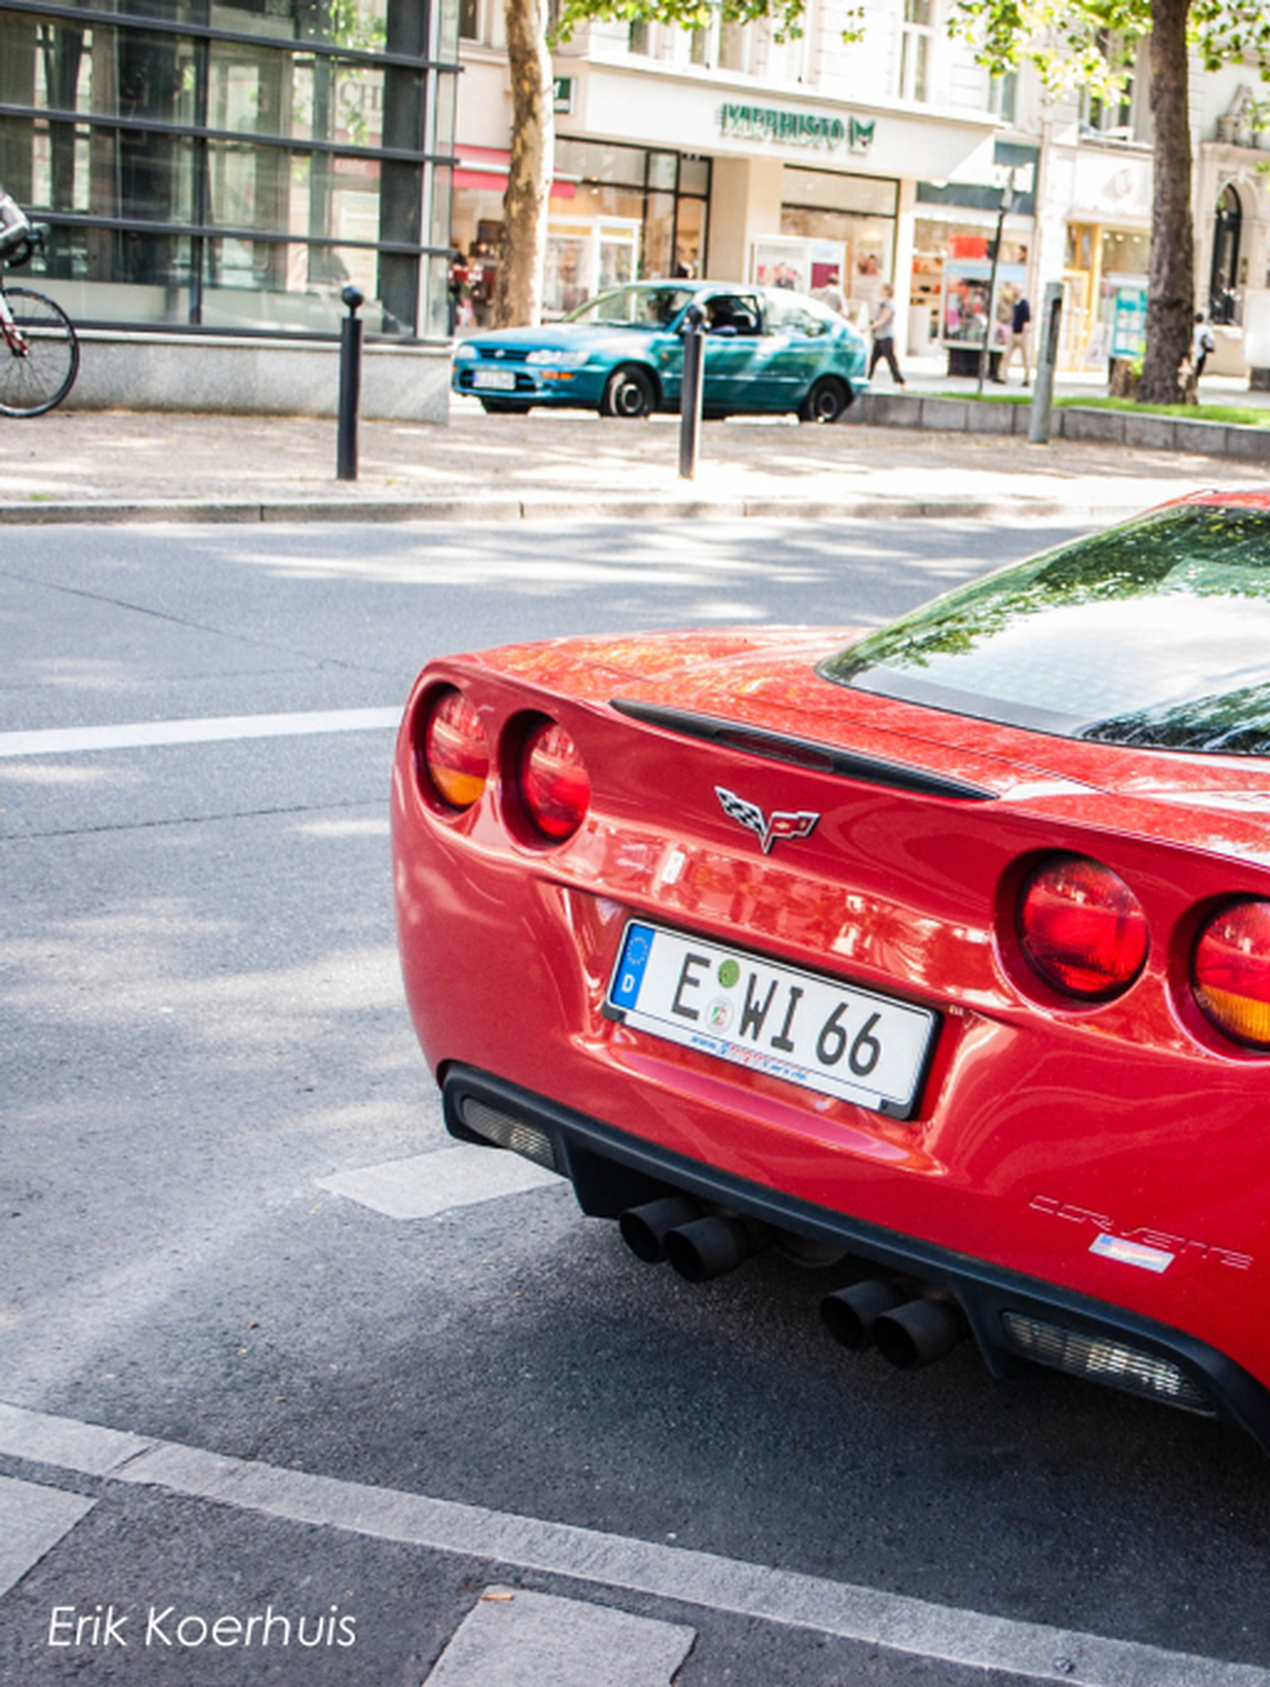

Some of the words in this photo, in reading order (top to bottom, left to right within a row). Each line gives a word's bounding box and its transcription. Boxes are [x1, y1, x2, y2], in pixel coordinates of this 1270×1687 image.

[719, 102, 846, 148] MEPHISTO
[621, 973, 635, 993] D
[671, 952, 711, 1021] E
[739, 972, 804, 1053] WI
[816, 1001, 882, 1077] 66
[1028, 1194, 1255, 1271] CORVETTE
